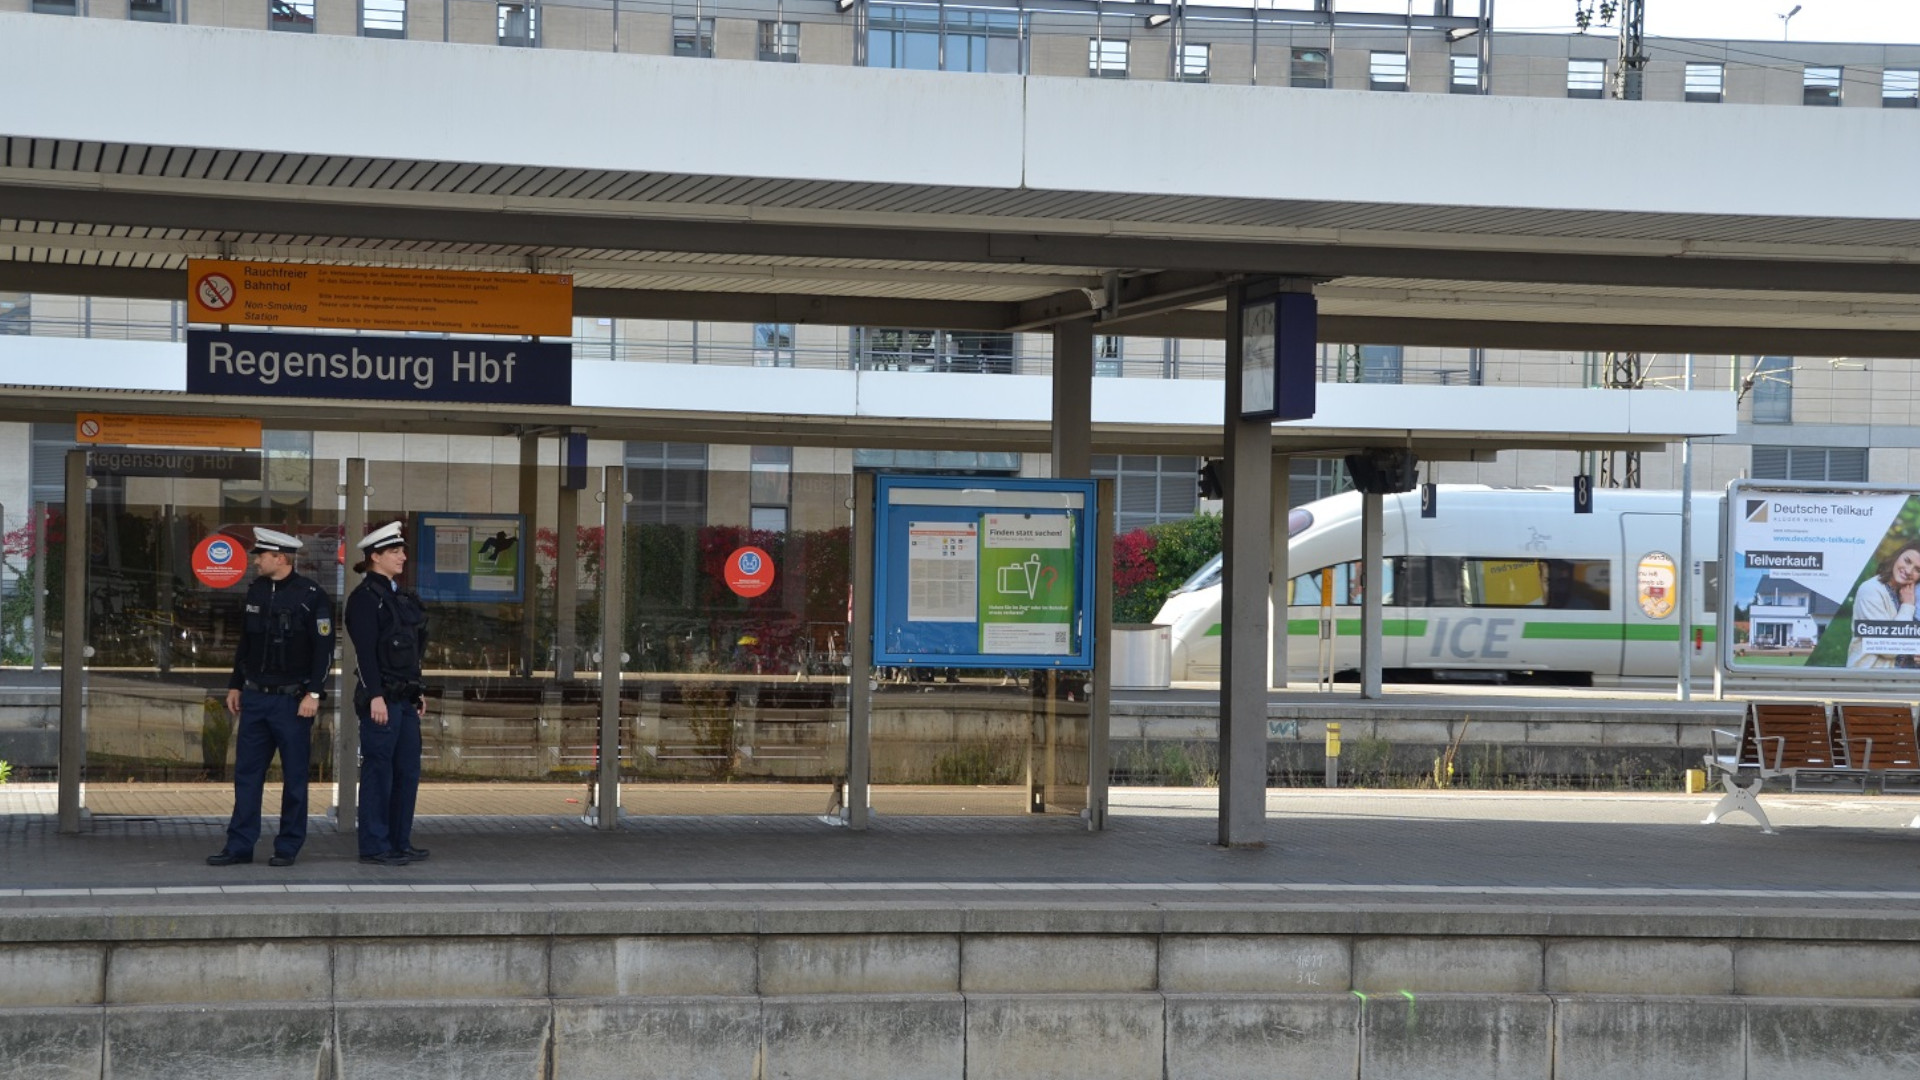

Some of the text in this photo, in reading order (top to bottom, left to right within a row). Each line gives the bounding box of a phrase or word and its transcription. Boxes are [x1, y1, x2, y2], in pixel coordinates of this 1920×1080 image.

[244, 266, 308, 278] Rauchfreier
[244, 280, 291, 292] Bahnhof
[244, 300, 308, 313] Non-Smoking
[244, 312, 279, 322] Station
[209, 341, 517, 390] Regensburg Hbf
[86, 451, 234, 473] Regensburg Hbf
[1422, 486, 1430, 511] 9
[1578, 479, 1588, 506] 8
[1774, 503, 1873, 517] Deutsche Teilkauf
[1773, 536, 1866, 544] www.deutsche-teilkauf.de
[1748, 554, 1820, 568] Teilverkauft.
[1857, 623, 1888, 636] Ganz
[1429, 616, 1517, 659] ICE
